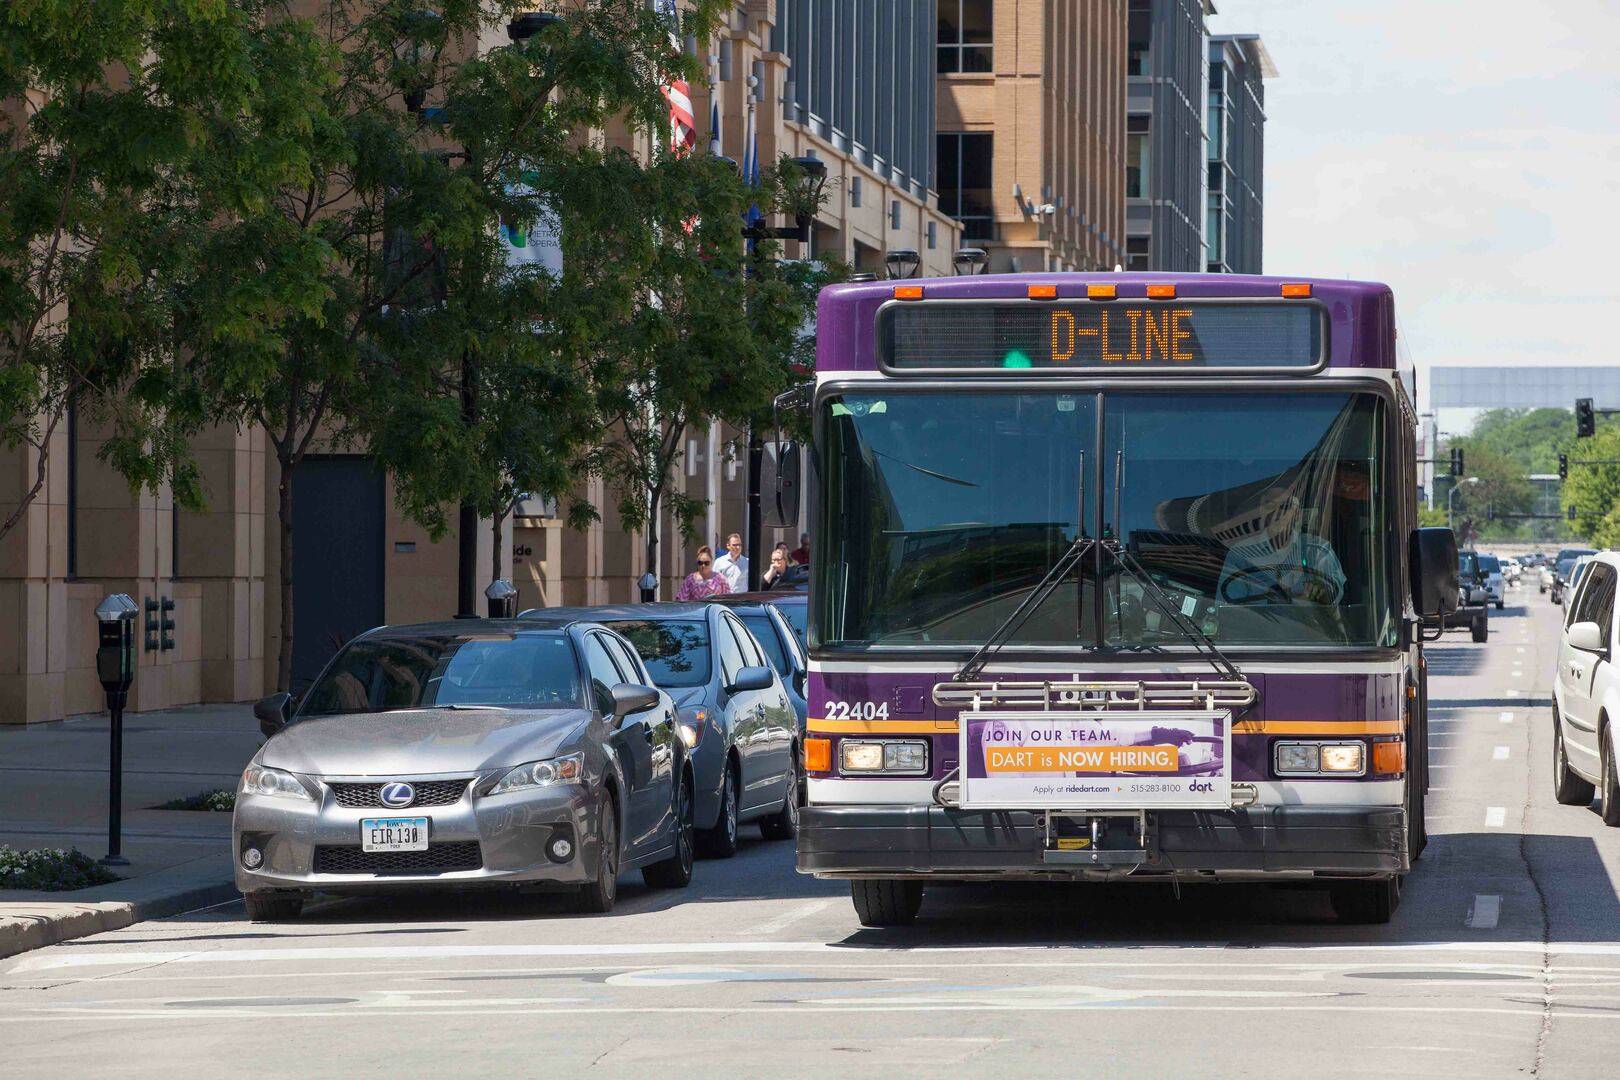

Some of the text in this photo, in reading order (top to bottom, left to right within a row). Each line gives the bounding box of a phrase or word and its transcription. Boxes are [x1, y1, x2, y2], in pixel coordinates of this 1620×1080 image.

[1051, 310, 1193, 360] D-LINE
[824, 701, 889, 720] 22404
[985, 730, 1117, 741] JOIN OUR TEAM.
[992, 751, 1174, 767] DART is NOW HIRING.
[1033, 784, 1110, 795] Apply at ridedart.com
[1130, 784, 1181, 793] 515-283-8100
[371, 827, 418, 844] EIR 130
